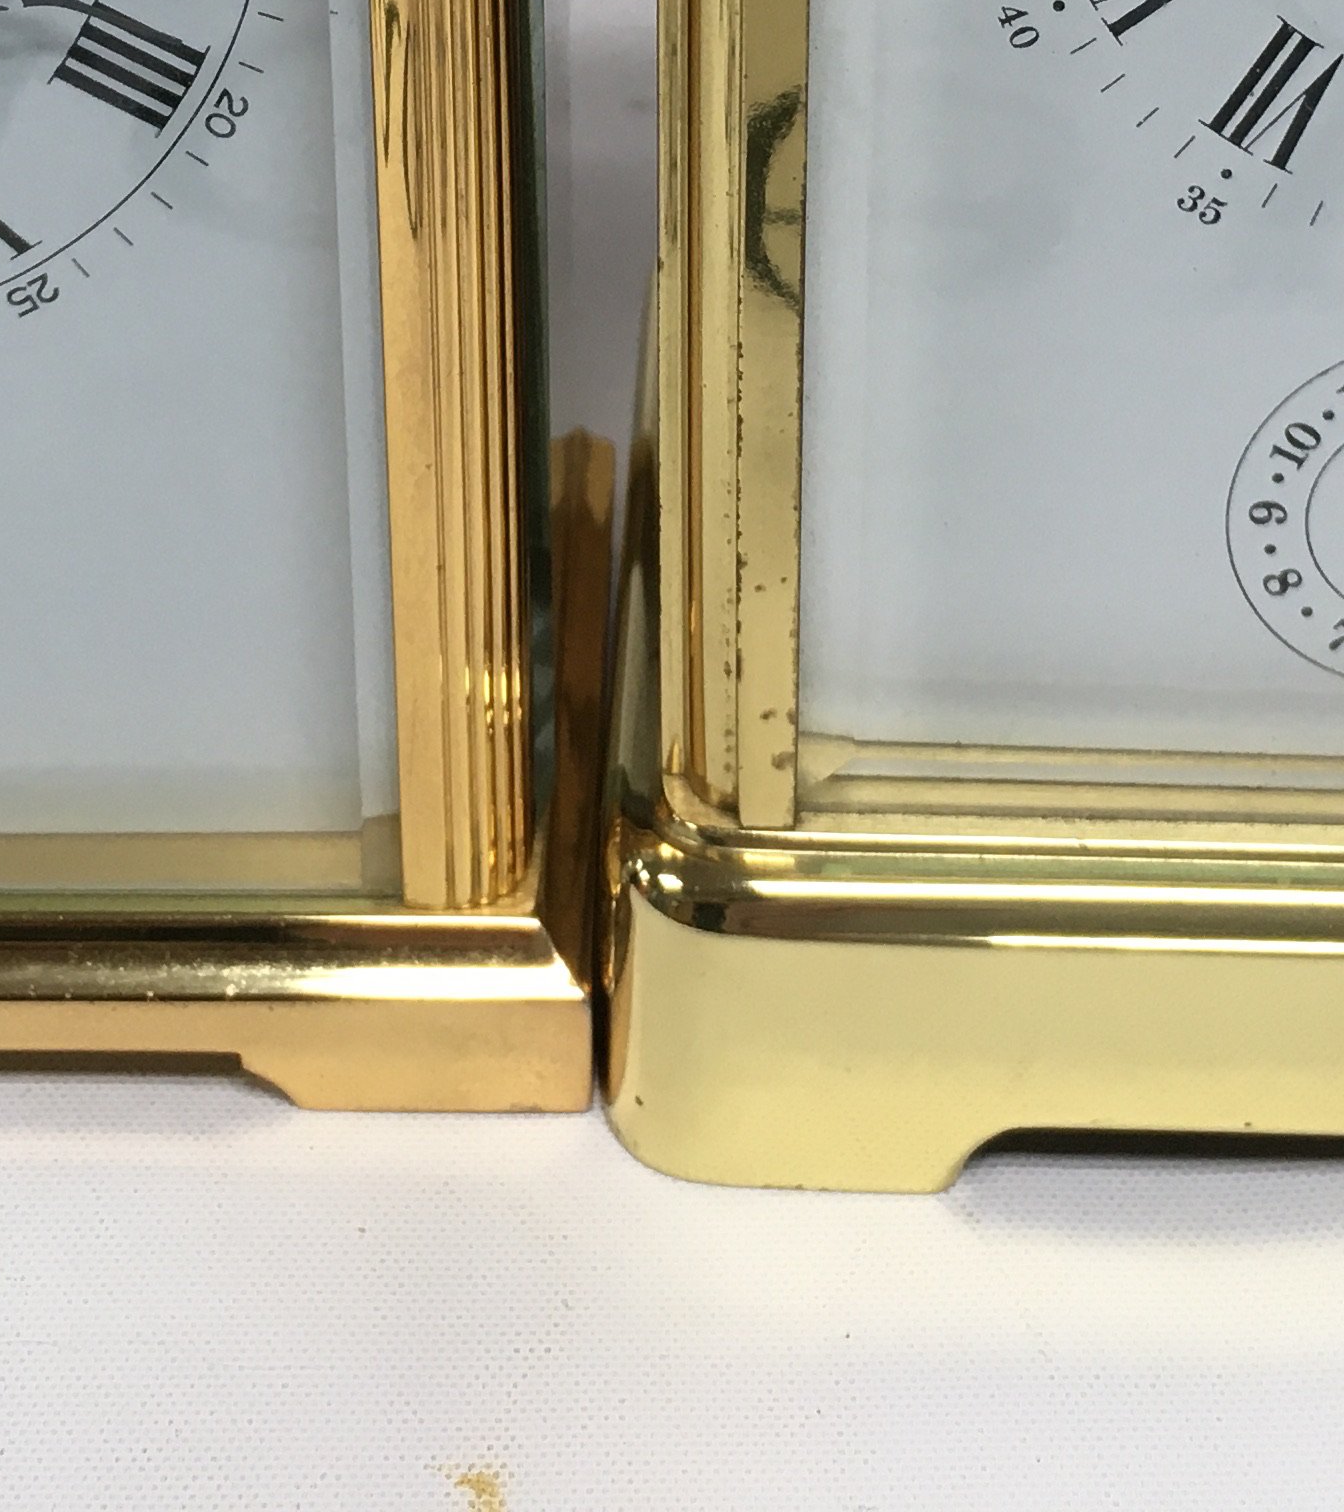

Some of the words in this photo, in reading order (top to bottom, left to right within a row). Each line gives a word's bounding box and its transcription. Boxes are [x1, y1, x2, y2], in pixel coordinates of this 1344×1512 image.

[997, 5, 1040, 49] 40
[204, 88, 249, 138] 20
[1198, 15, 1344, 174] VII
[1176, 184, 1228, 225] 35
[6, 273, 60, 316] 25
[1269, 422, 1322, 470] 10
[1248, 500, 1288, 526] 9
[1262, 568, 1303, 597] 8
